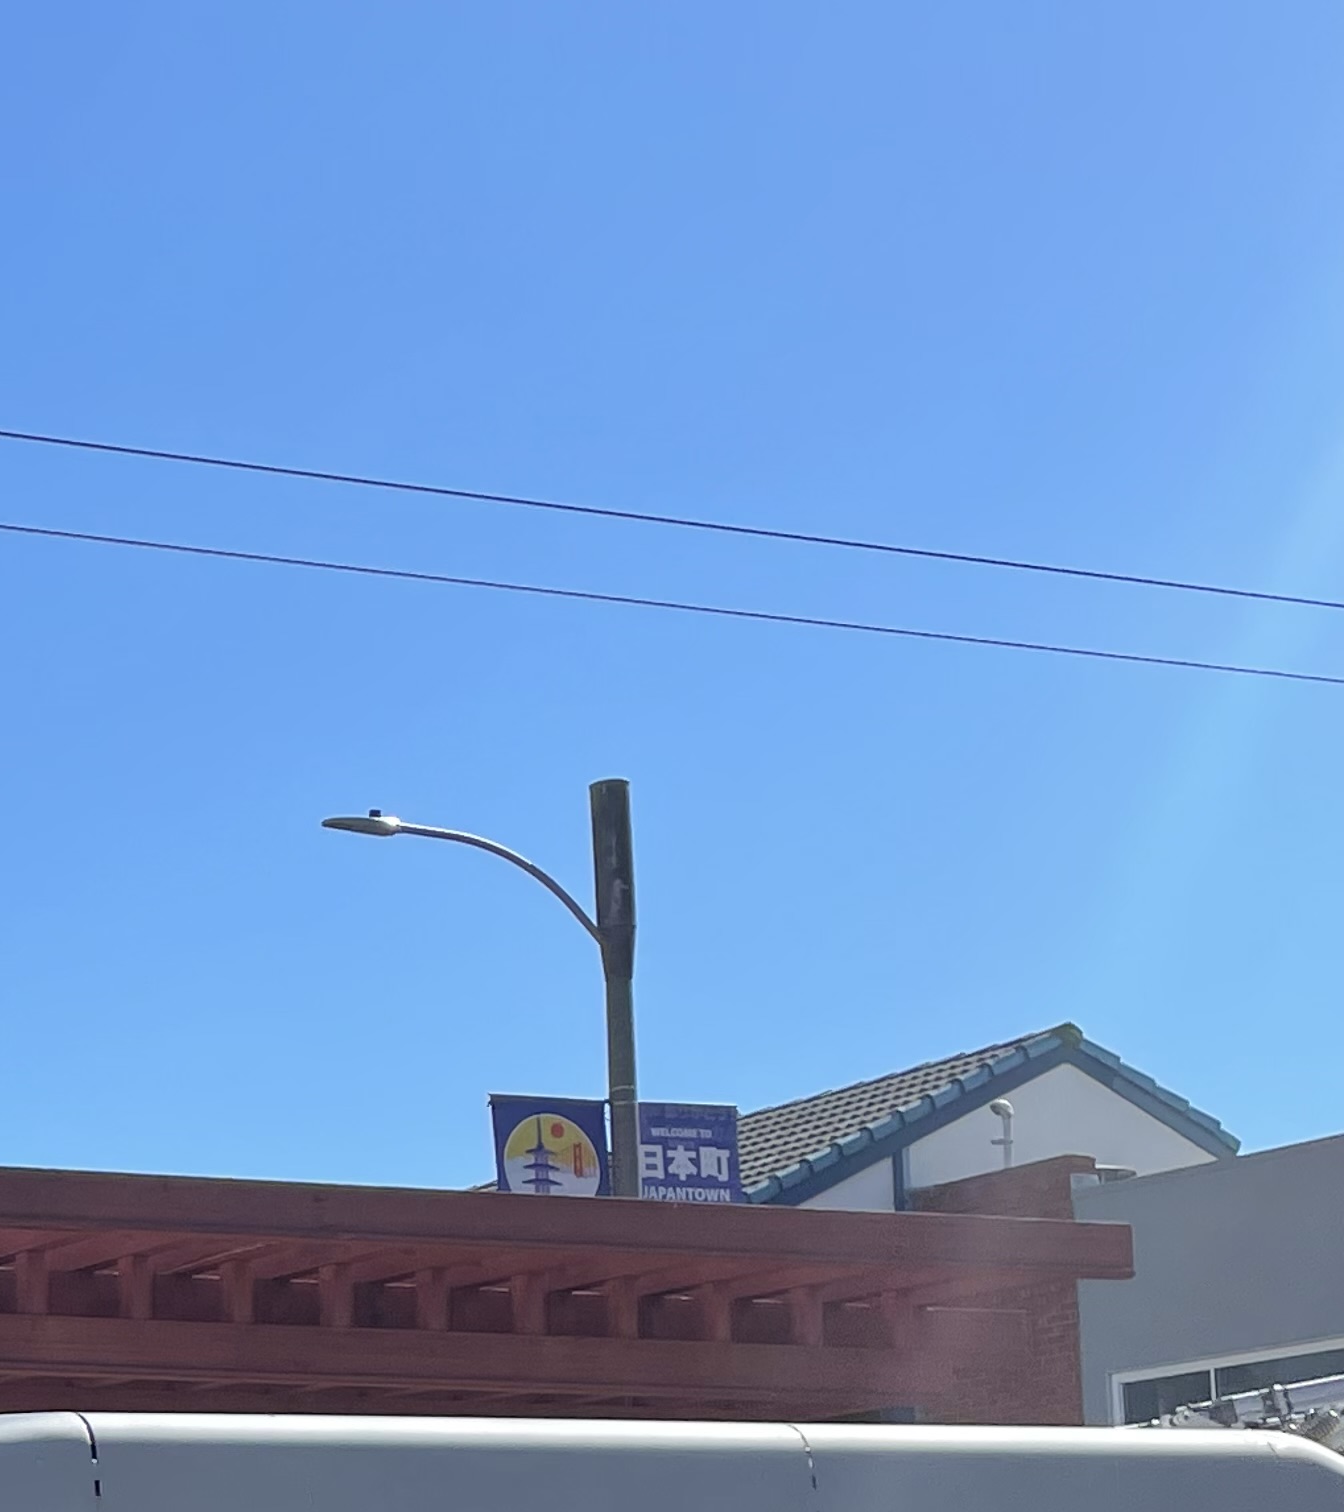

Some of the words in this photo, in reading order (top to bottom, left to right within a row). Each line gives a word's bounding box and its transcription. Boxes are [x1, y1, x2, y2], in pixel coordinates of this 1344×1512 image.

[651, 1127, 698, 1138] WELCOME
[699, 1129, 713, 1139] TO
[640, 1144, 730, 1182] 日本町
[643, 1185, 731, 1202] JAPANTOWN
